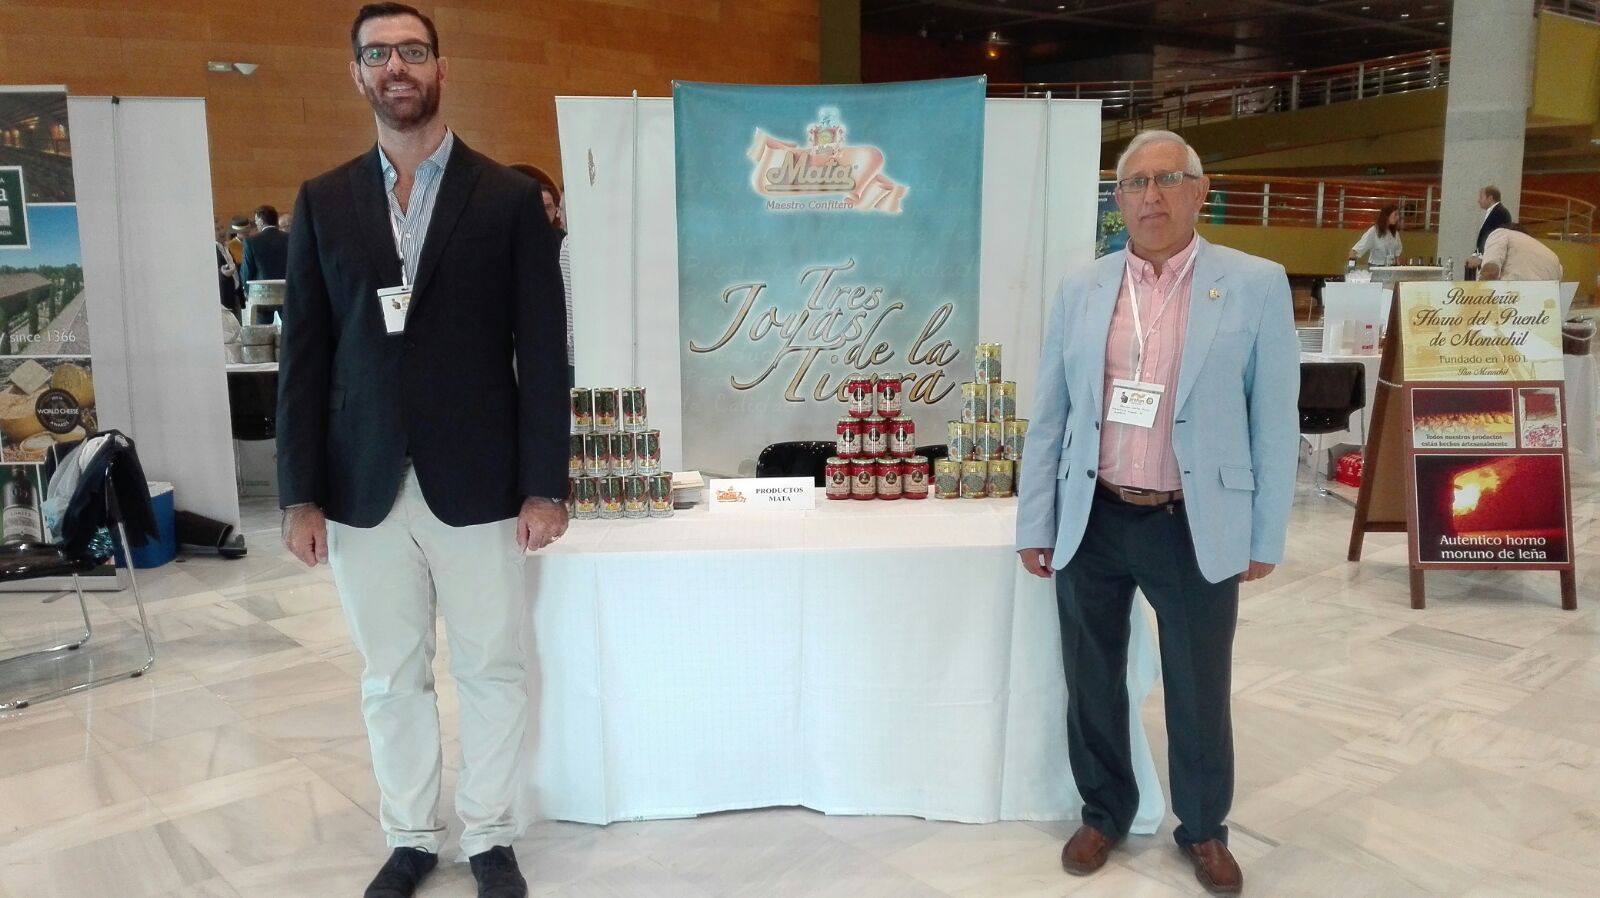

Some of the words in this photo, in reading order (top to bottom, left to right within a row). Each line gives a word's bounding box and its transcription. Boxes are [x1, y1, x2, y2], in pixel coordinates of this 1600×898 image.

[765, 150, 856, 189] Mata
[766, 200, 806, 210] Maestro
[808, 200, 855, 211] Confitero
[801, 257, 883, 311] Tres
[1442, 287, 1519, 305] Panadería
[1413, 307, 1463, 326] Horno
[1467, 310, 1491, 326] del
[1496, 307, 1550, 326] Puente
[9, 331, 41, 343] since
[47, 329, 76, 343] 1366
[689, 283, 868, 389] Joyas
[844, 302, 905, 369] de
[907, 302, 960, 366] la
[1429, 332, 1445, 347] de
[1450, 329, 1530, 347] Monachil
[1439, 354, 1483, 364] Fundado
[1485, 356, 1498, 364] en
[770, 336, 956, 404] Tiera
[1440, 534, 1502, 545] Autentico
[1506, 534, 1546, 545] horno
[1441, 550, 1495, 559] moruno
[1498, 548, 1515, 559] de
[1518, 548, 1547, 559] leña
